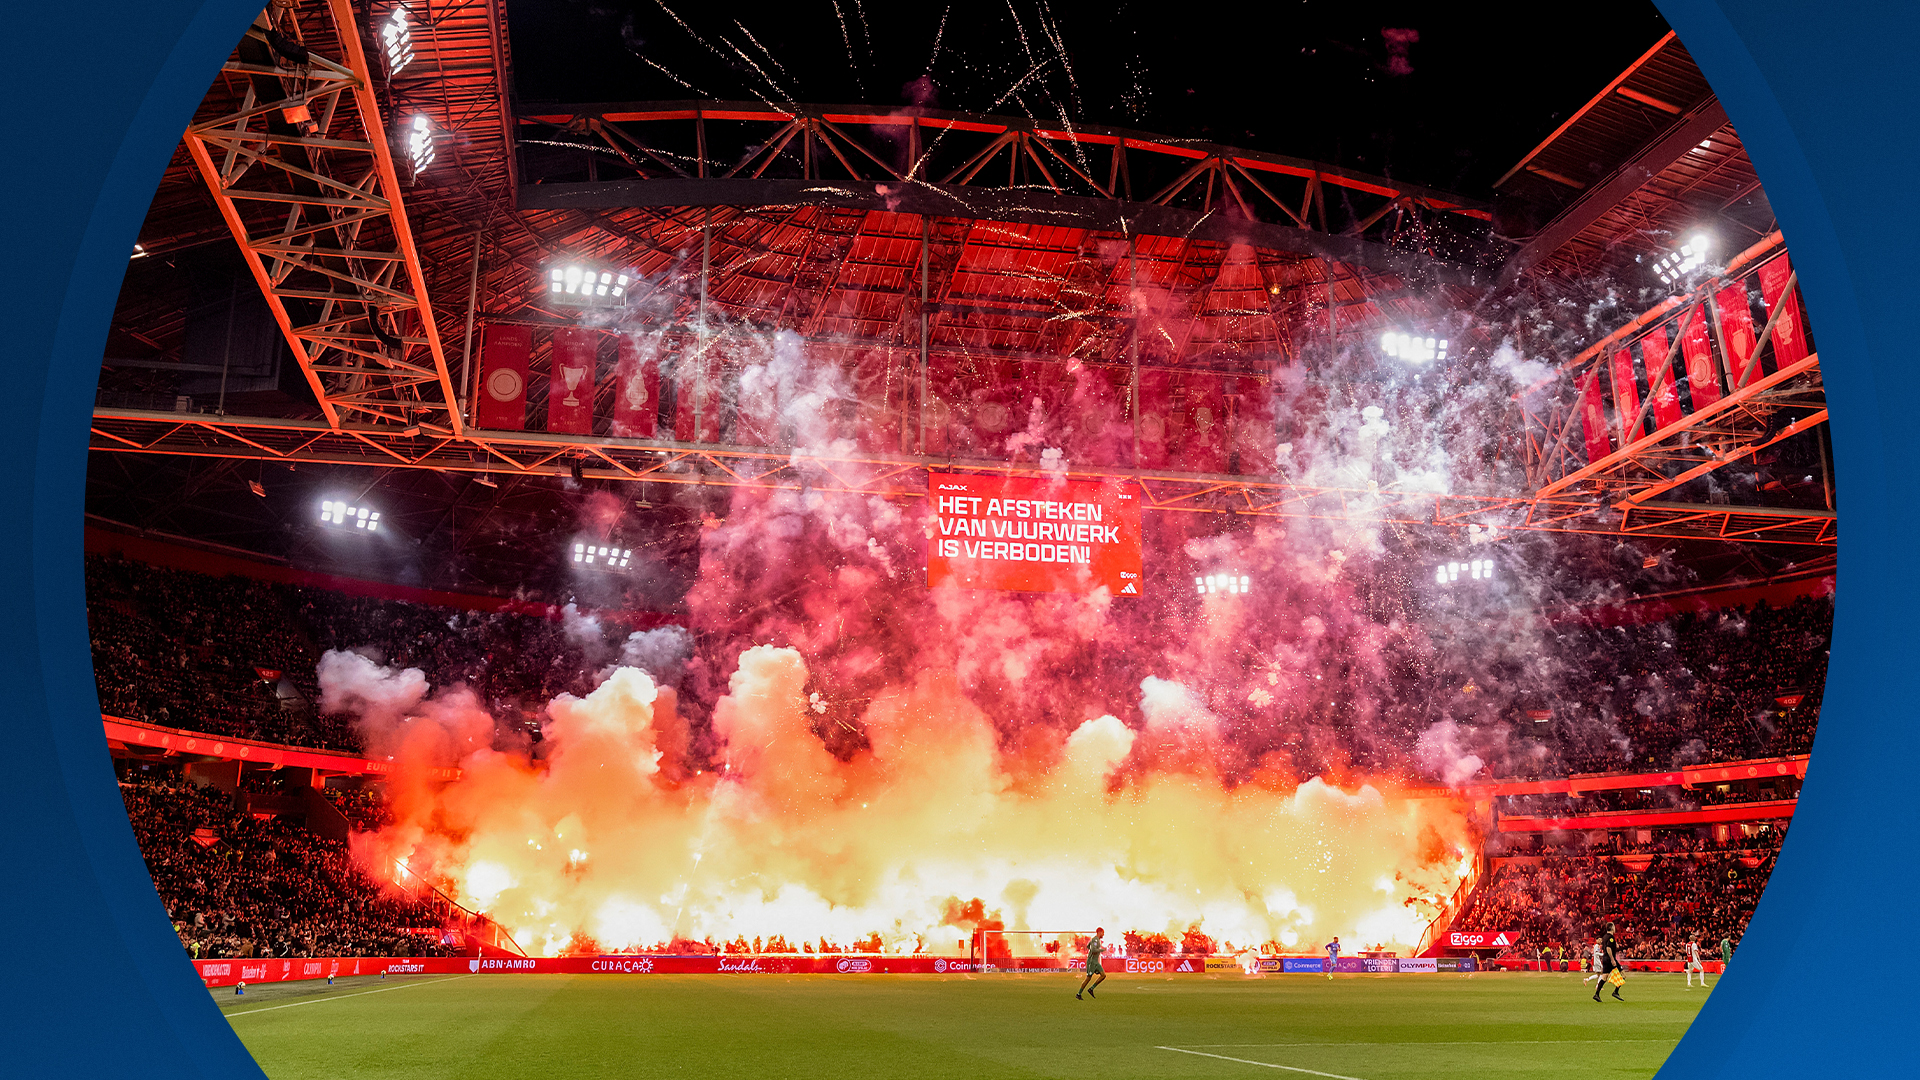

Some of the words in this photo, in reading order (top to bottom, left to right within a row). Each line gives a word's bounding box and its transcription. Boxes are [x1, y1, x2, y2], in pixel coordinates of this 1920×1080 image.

[939, 495, 982, 515] HET
[986, 498, 1102, 522] AFSTEKEN
[938, 517, 986, 537] VAN
[991, 519, 1120, 544] VUURWERK
[938, 538, 959, 558] IS
[964, 540, 1091, 564] VERBODEN!
[1430, 788, 1453, 796] CUP
[388, 964, 417, 972] ROCKSTARS
[718, 958, 762, 971] Sandals
